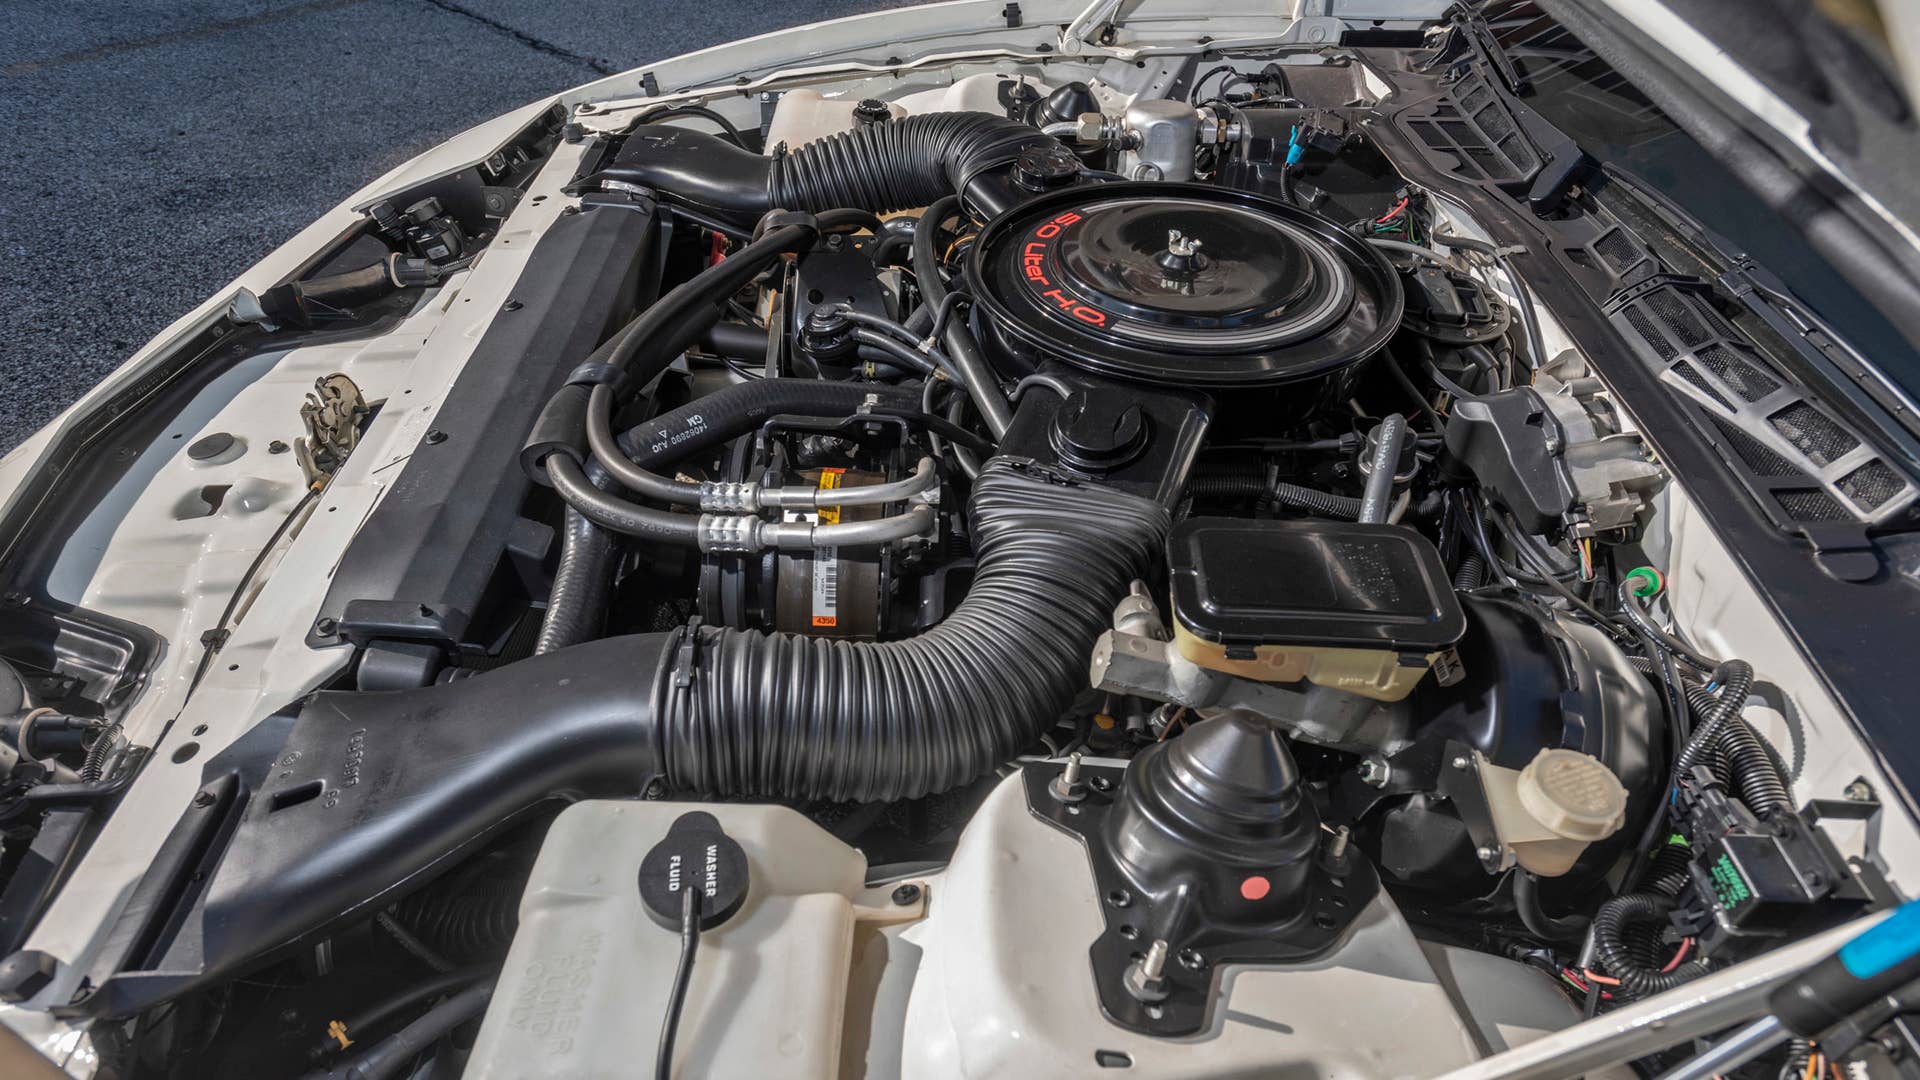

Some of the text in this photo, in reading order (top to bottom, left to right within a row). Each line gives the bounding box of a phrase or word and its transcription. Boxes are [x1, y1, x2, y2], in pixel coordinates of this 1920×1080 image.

[1024, 211, 1106, 327] 5.0 Liter H.O.
[686, 414, 704, 427] GM
[668, 855, 681, 892] FLUID
[705, 844, 717, 898] WASHER
